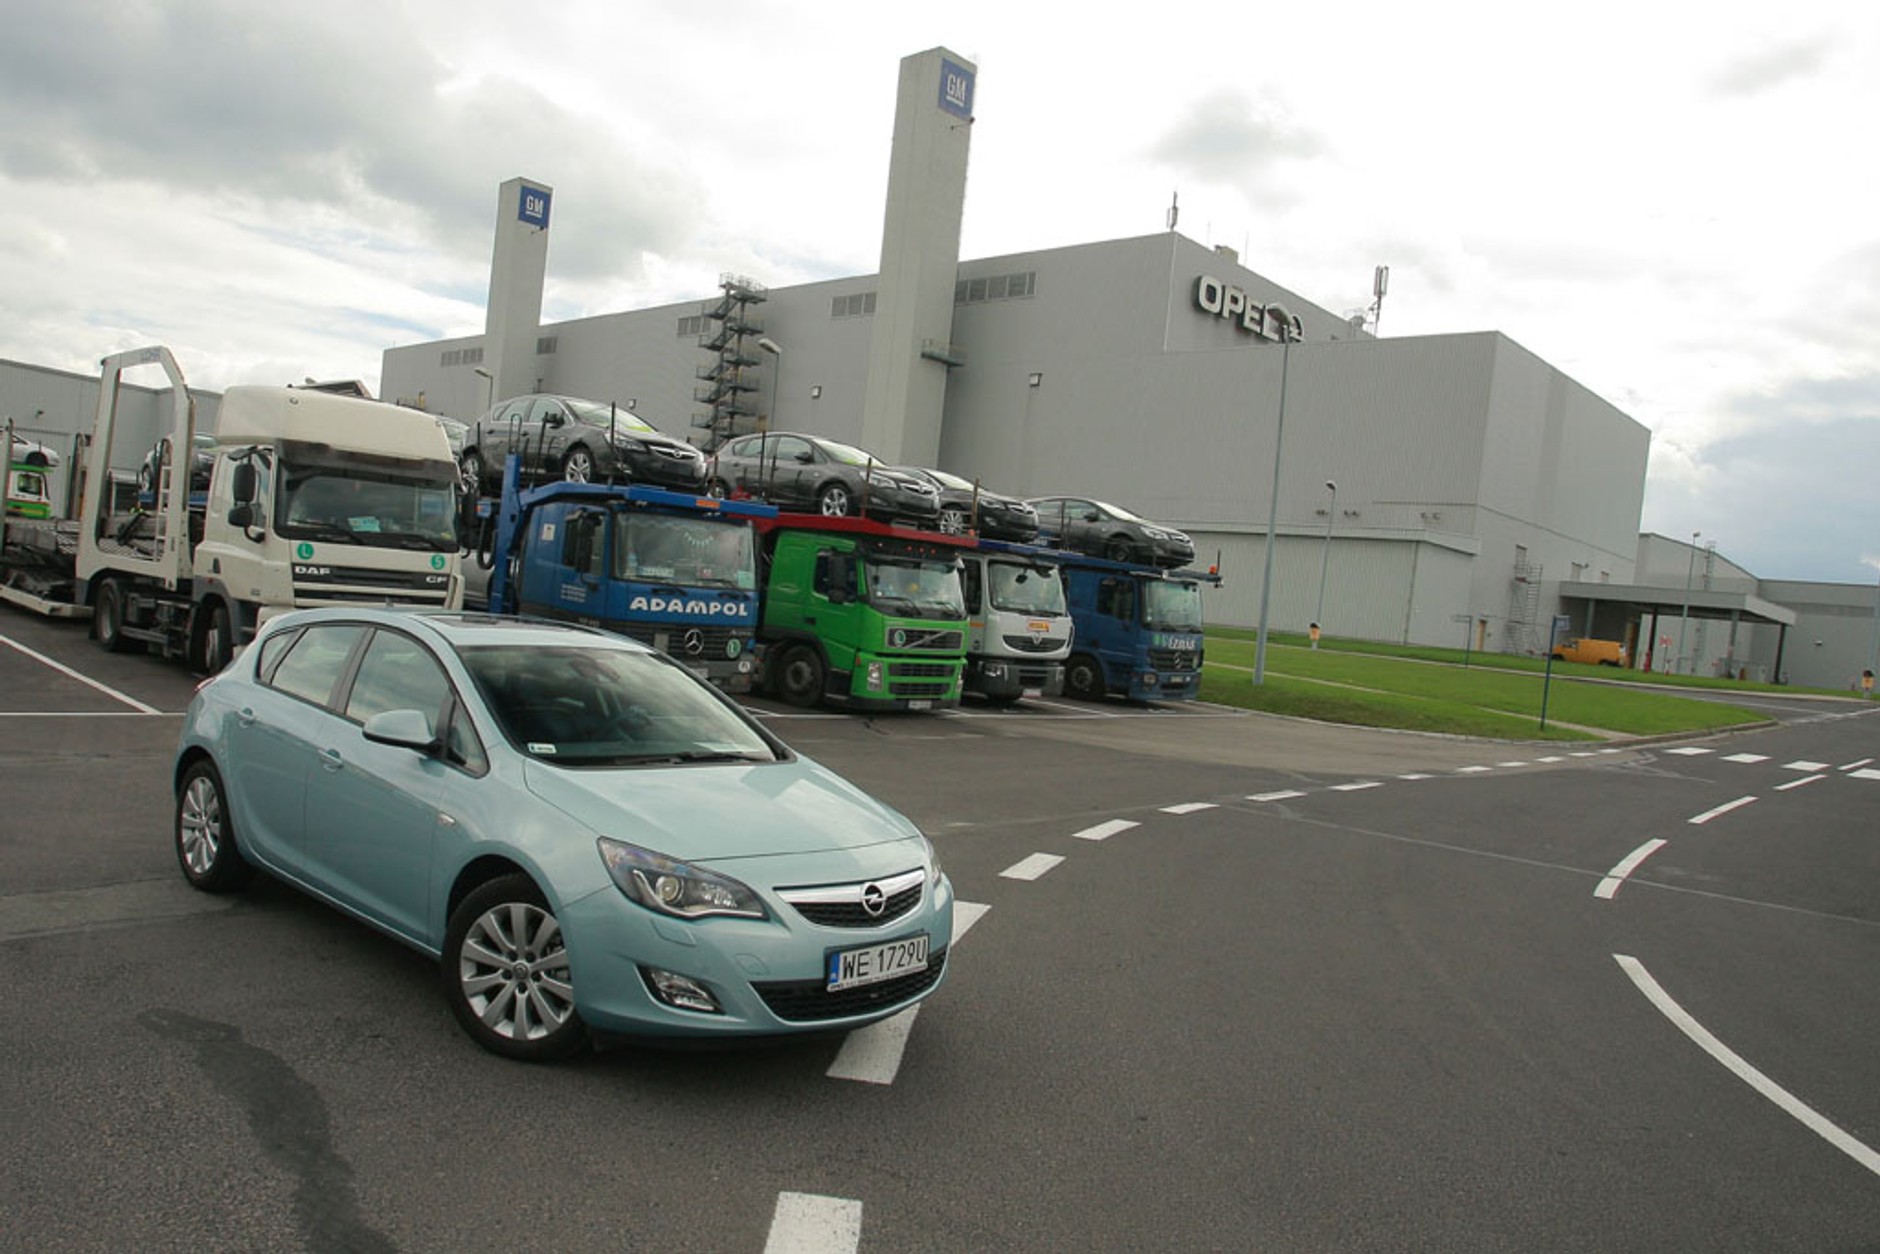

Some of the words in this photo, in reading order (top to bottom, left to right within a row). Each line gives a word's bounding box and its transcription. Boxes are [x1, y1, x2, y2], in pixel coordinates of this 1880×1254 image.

[947, 73, 966, 101] GM
[526, 195, 544, 215] GM
[1198, 275, 1281, 342] OPEL
[294, 565, 331, 576] DAF
[629, 596, 748, 617] ADAMPOL
[842, 950, 870, 980] WE
[878, 938, 927, 973] 1729U
